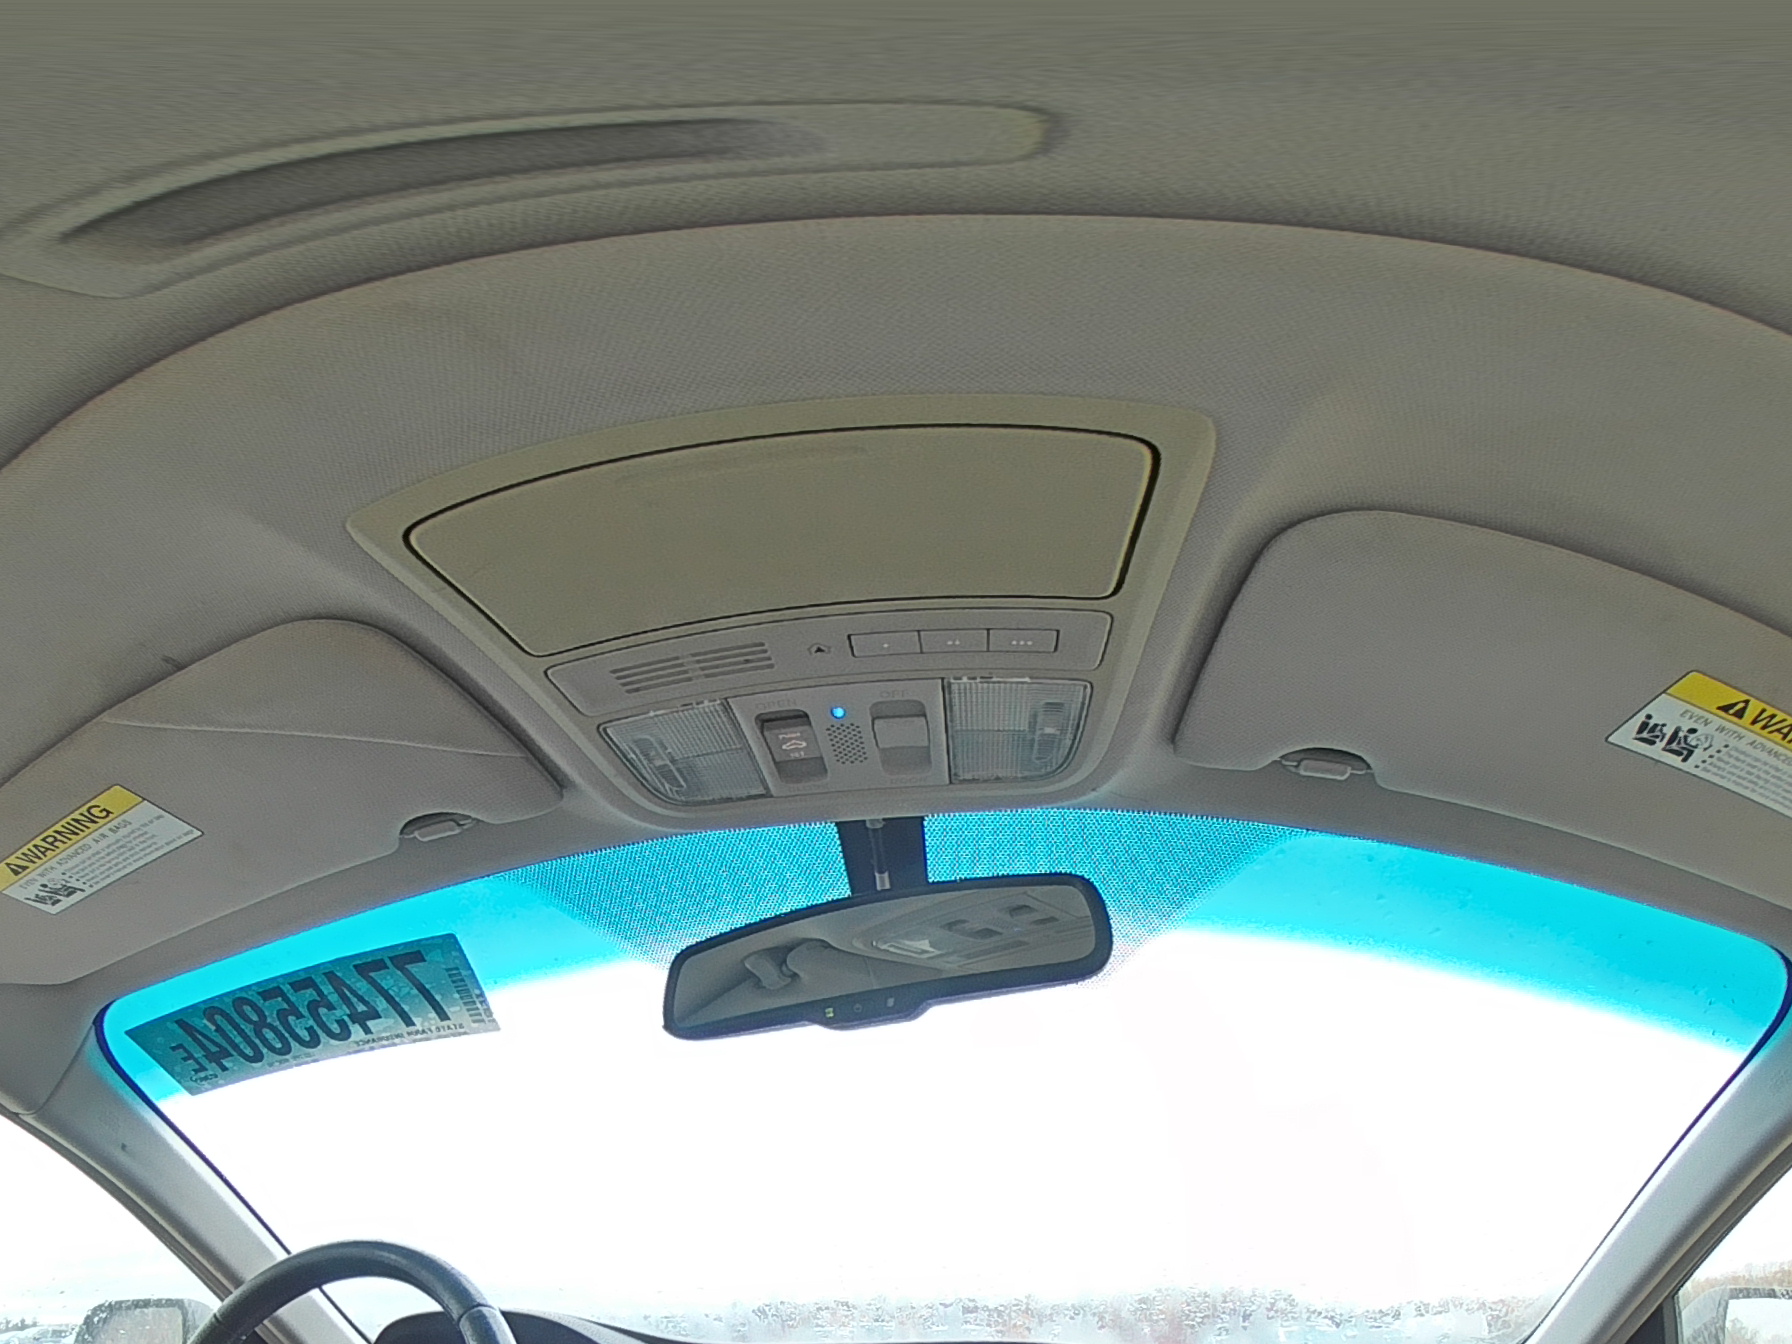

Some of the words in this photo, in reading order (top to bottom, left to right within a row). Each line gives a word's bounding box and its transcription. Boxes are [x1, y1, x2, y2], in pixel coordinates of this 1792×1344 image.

[1680, 709, 1713, 727] EVEN
[1714, 724, 1746, 742] WITH
[15, 804, 114, 864] WARNING
[93, 833, 109, 845] AIR
